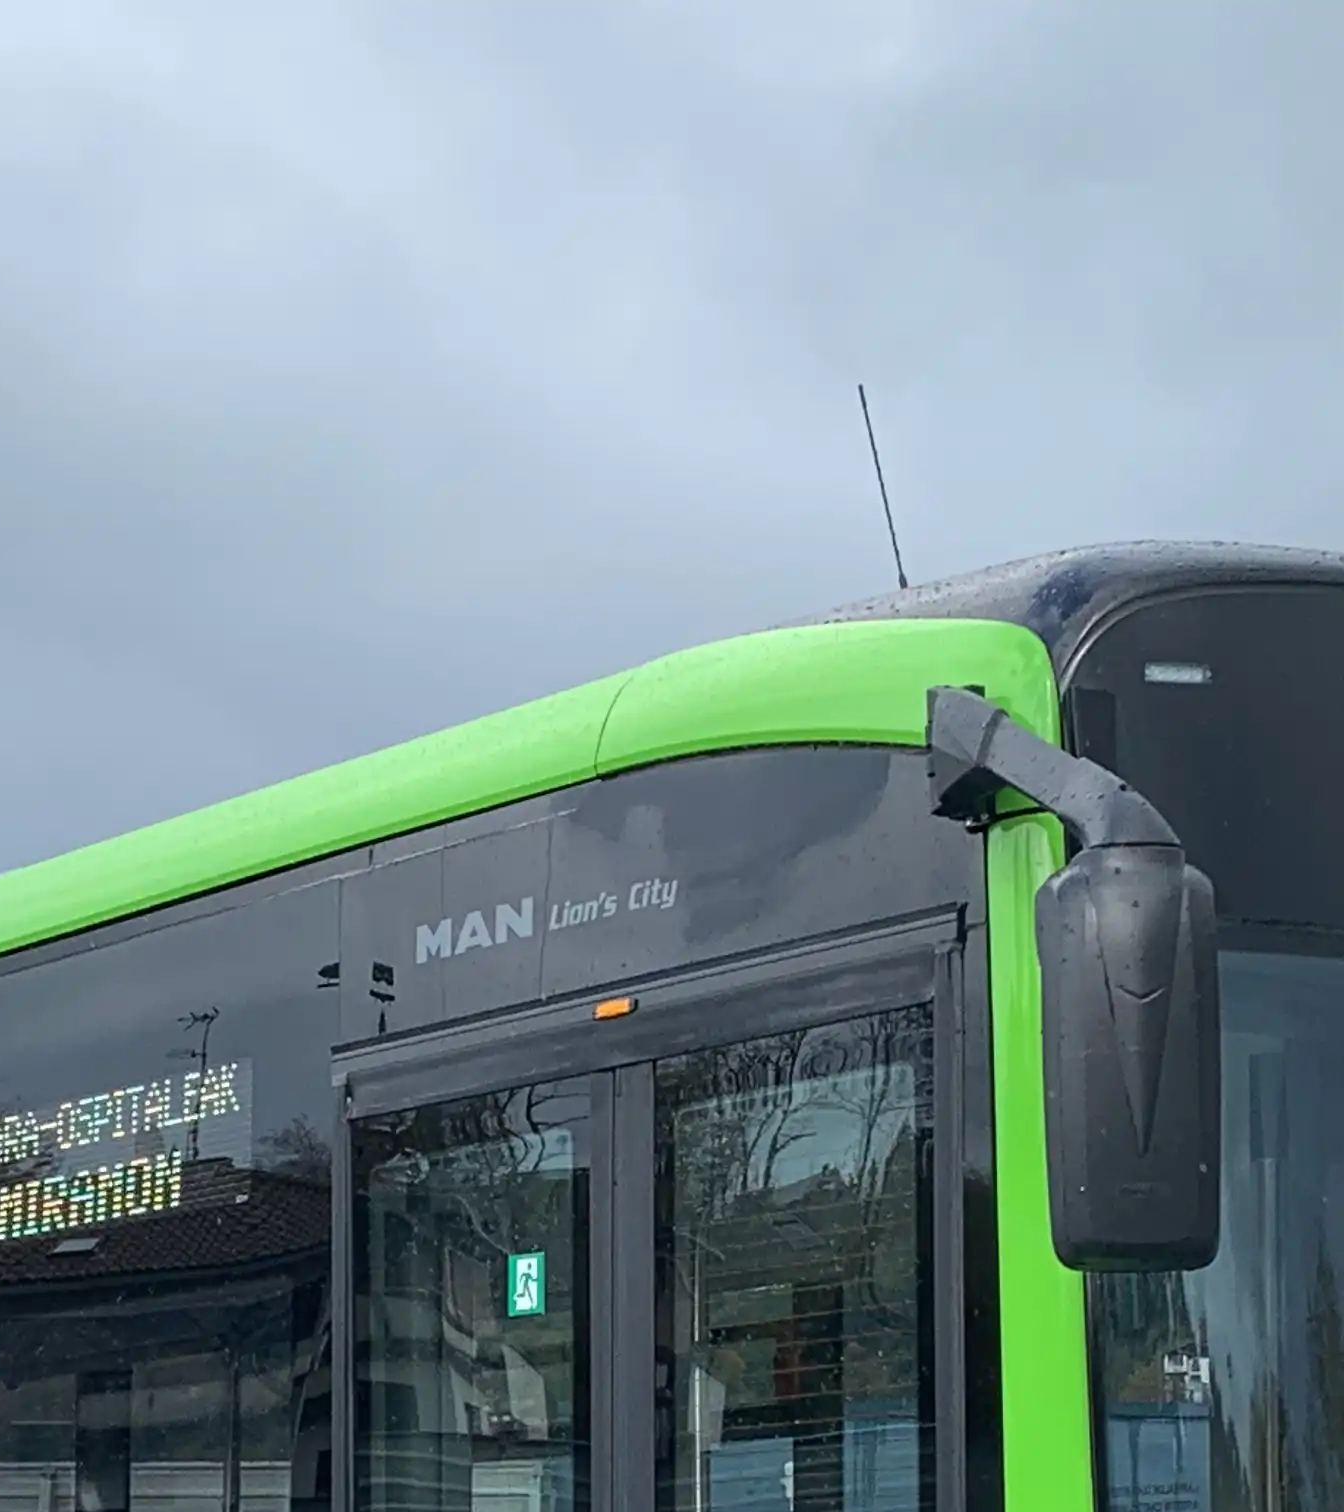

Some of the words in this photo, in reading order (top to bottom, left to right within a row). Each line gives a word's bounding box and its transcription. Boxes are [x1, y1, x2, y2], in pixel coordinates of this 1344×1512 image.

[415, 896, 534, 964] MAN
[549, 892, 617, 932] Lion's
[628, 877, 678, 911] City
